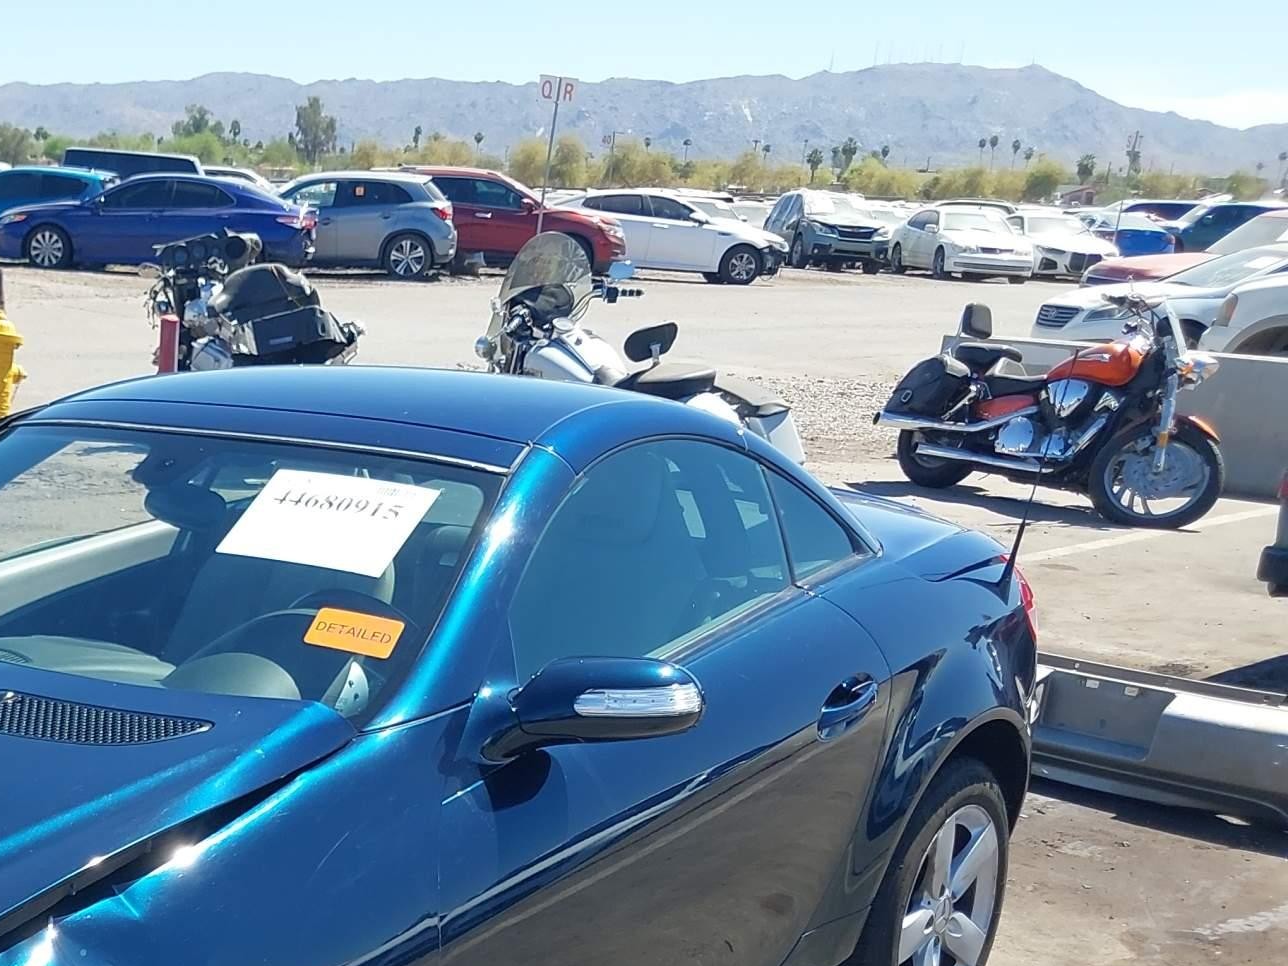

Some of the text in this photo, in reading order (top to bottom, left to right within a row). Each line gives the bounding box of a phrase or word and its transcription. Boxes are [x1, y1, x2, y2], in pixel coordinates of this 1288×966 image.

[541, 80, 553, 99] Q
[563, 82, 574, 101] R
[274, 490, 405, 520] 44680915
[315, 621, 392, 644] DETAILED
